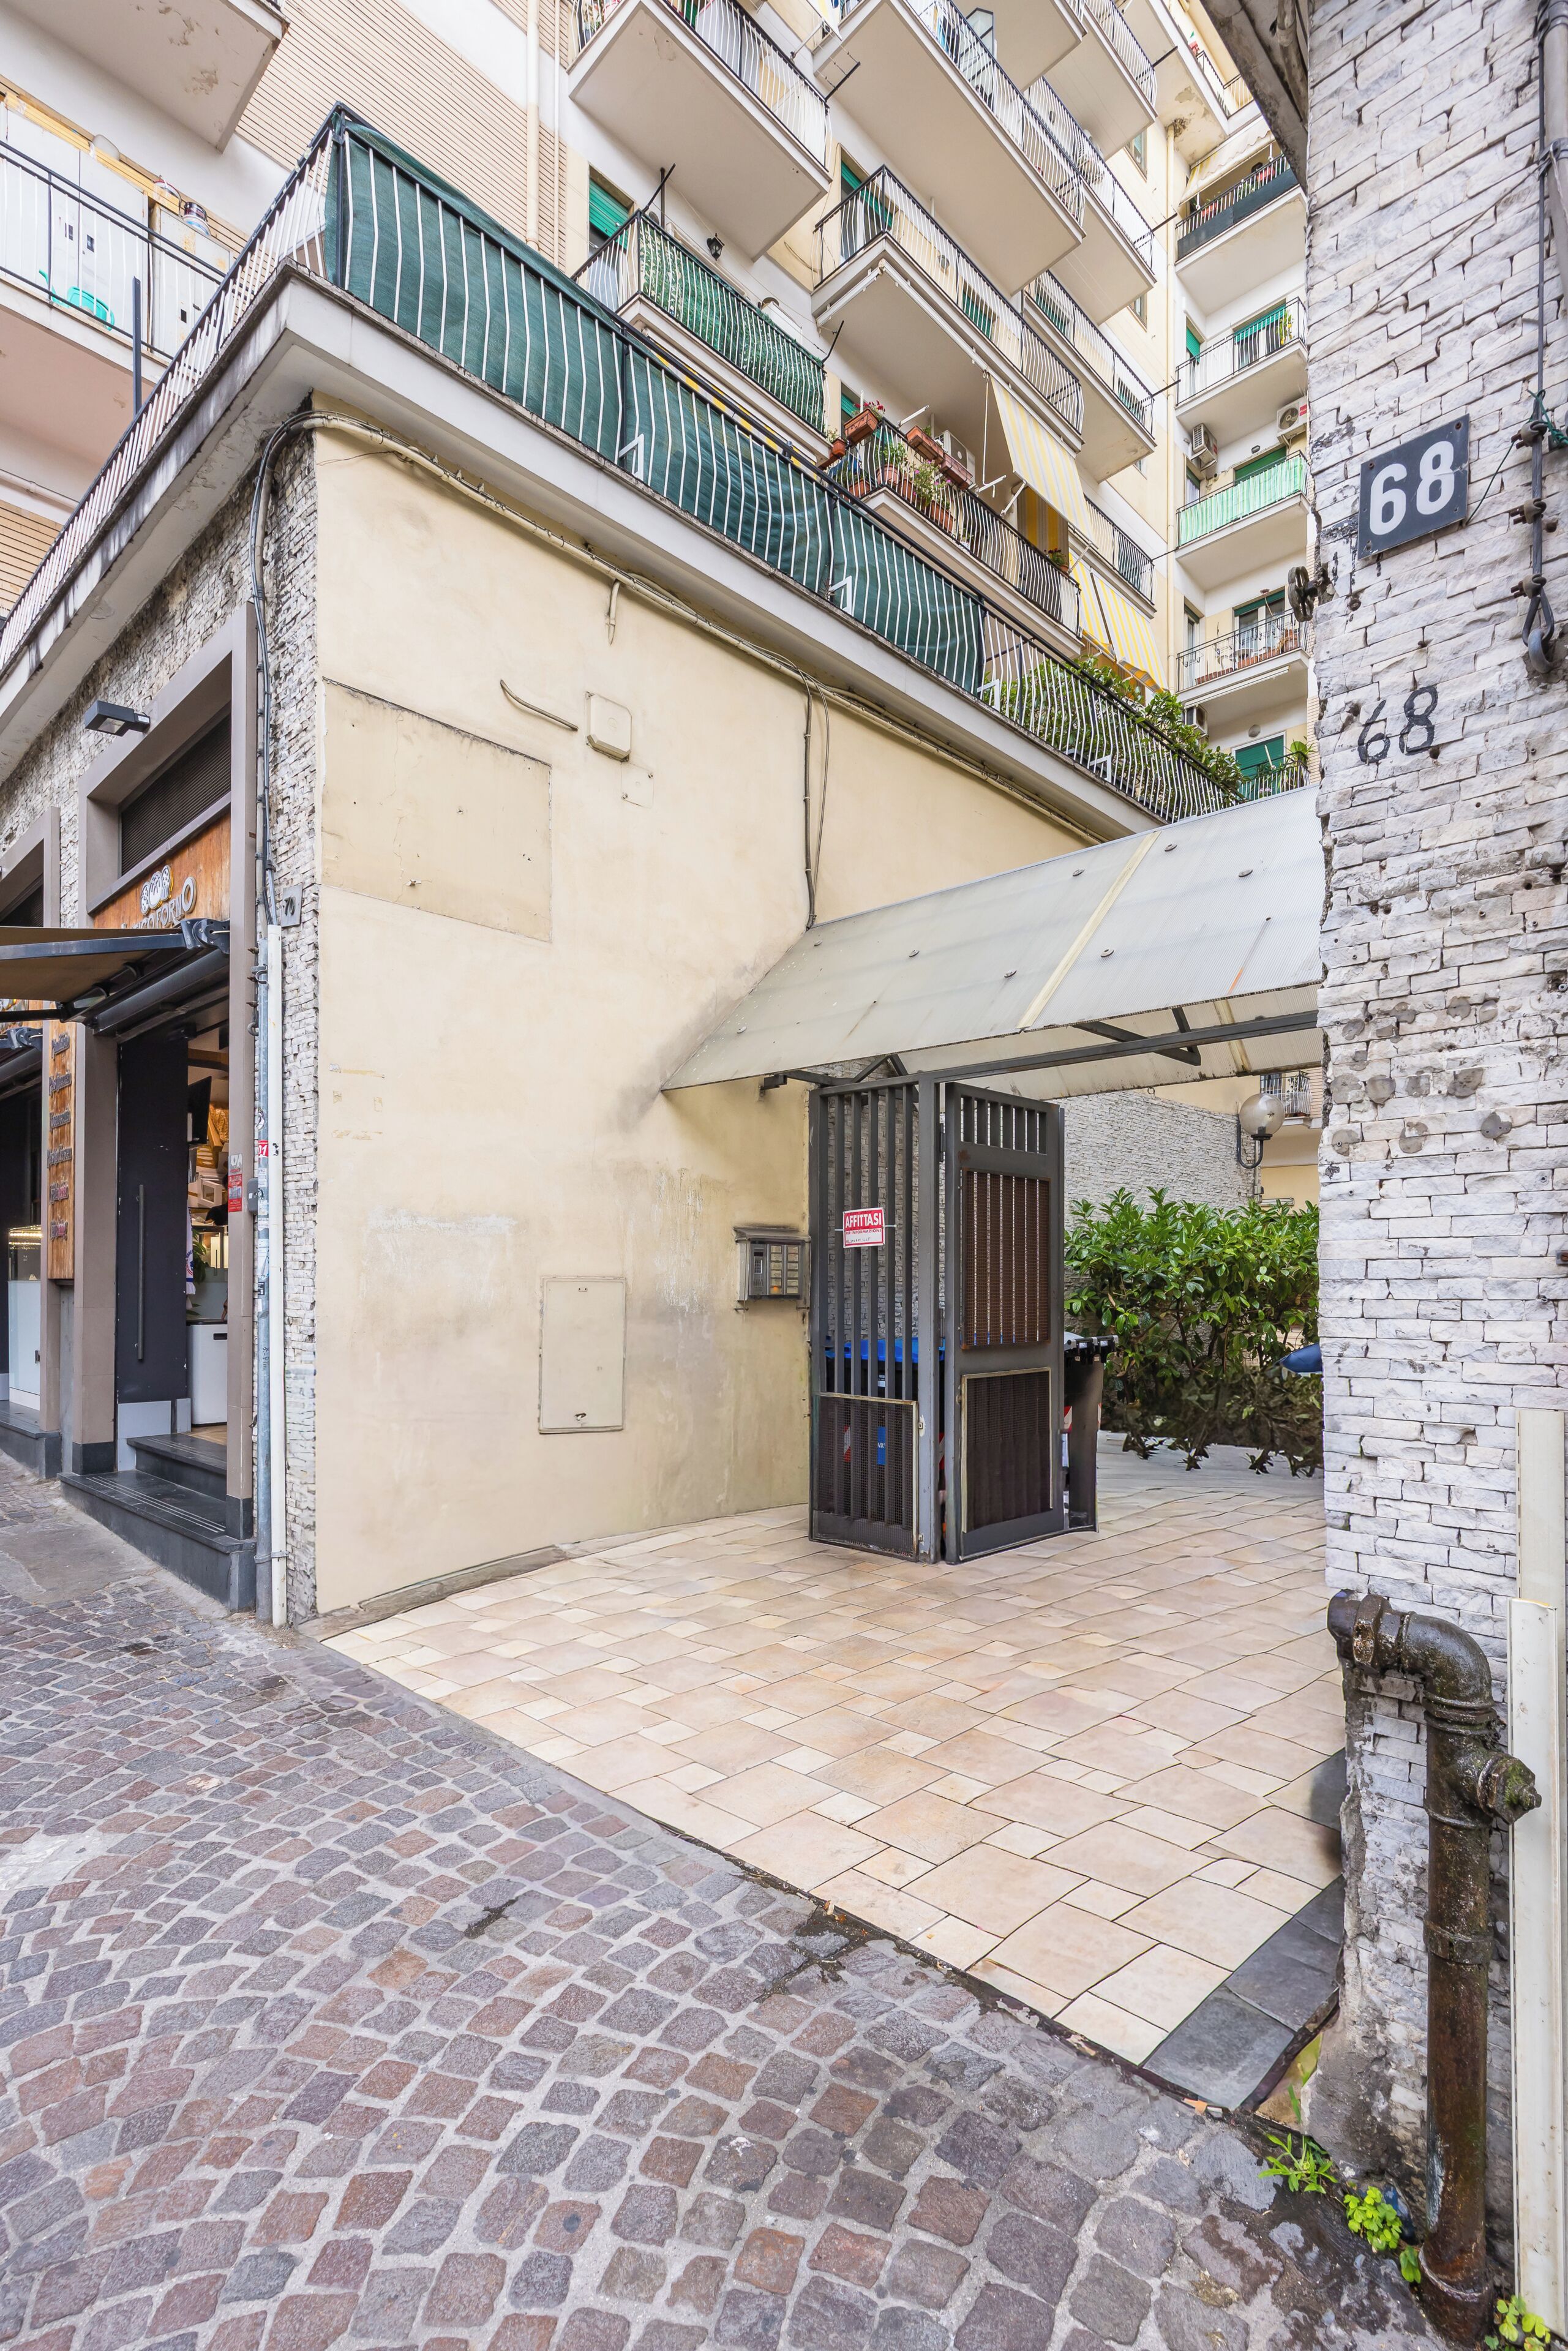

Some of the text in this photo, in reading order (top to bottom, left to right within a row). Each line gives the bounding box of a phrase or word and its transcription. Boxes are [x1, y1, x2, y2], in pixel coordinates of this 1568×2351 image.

[1370, 441, 1455, 536] 68
[1357, 685, 1438, 765] 68
[846, 1213, 882, 1228] AFFITTASI
